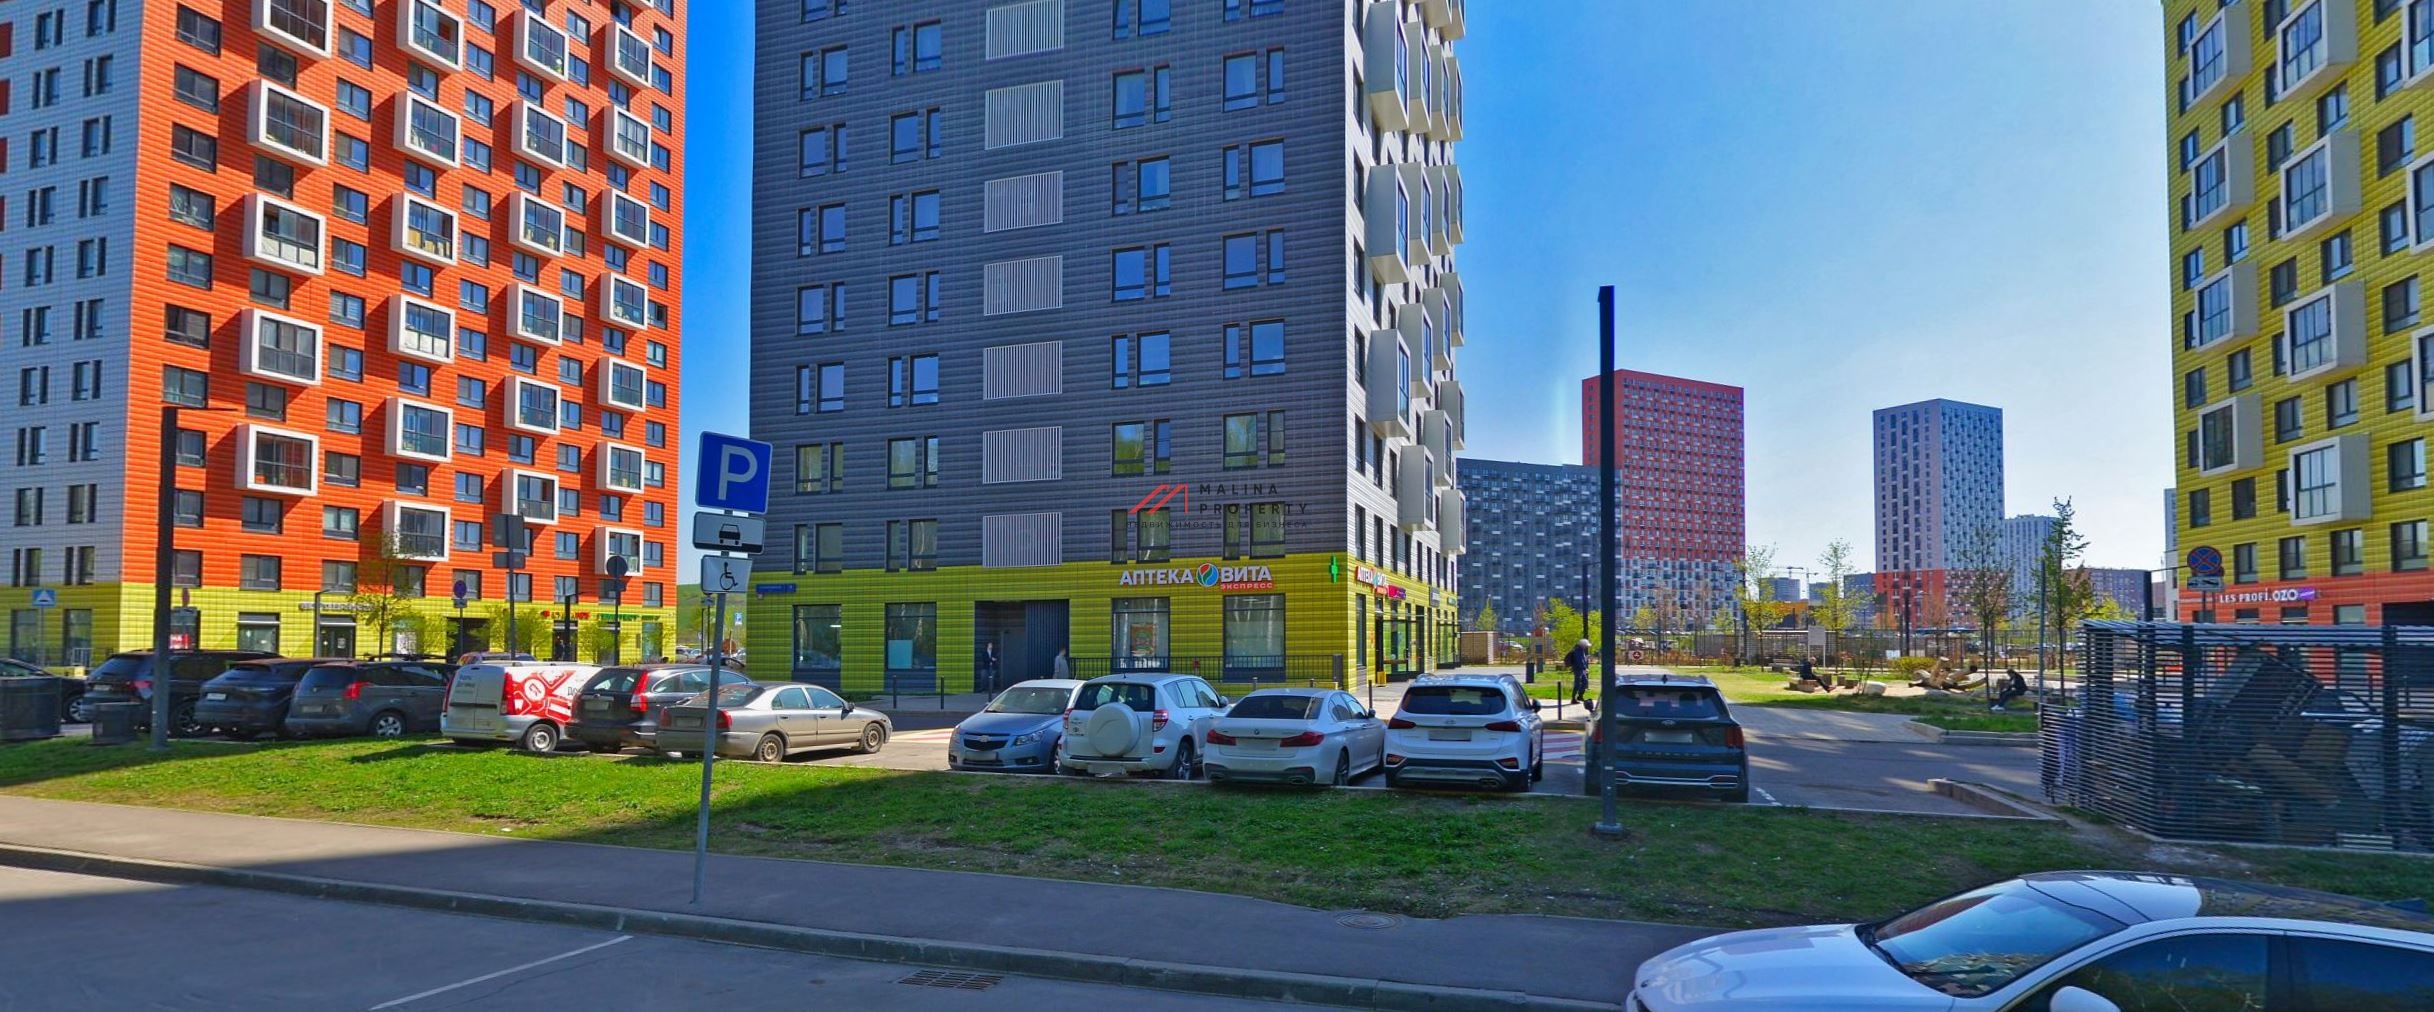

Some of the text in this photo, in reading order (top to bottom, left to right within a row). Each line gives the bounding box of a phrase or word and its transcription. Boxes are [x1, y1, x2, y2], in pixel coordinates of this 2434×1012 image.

[717, 443, 758, 501] P
[1119, 565, 1273, 586] АПТЕКА ВИТА
[1219, 582, 1274, 591] ЭКСПРЕСС
[2219, 594, 2237, 603] LES
